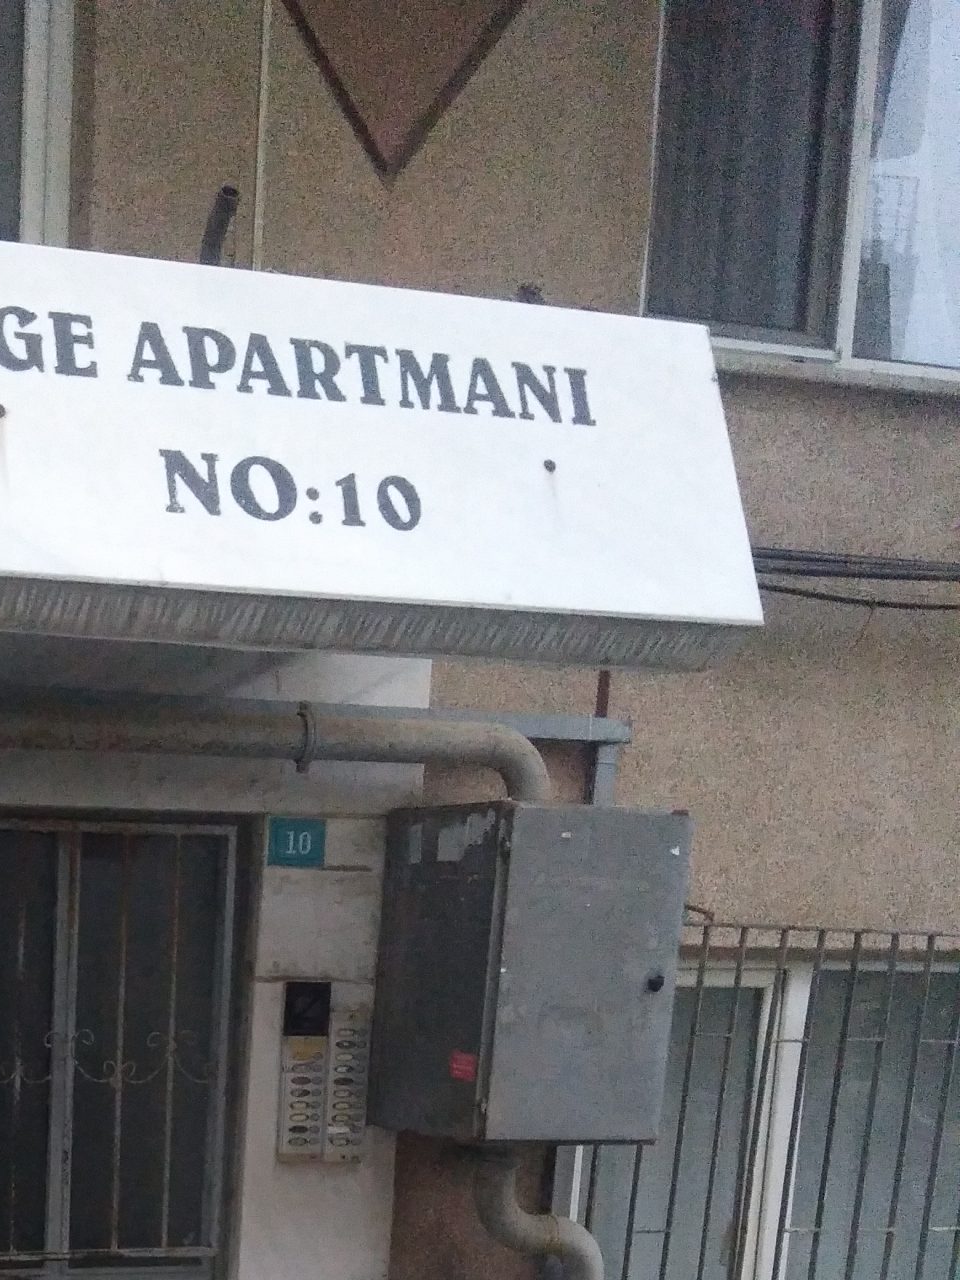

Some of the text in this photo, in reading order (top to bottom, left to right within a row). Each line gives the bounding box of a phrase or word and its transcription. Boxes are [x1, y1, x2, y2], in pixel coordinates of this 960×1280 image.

[127, 321, 597, 426] APARTMANI
[158, 449, 422, 531] NO:10
[286, 831, 312, 855] 10
